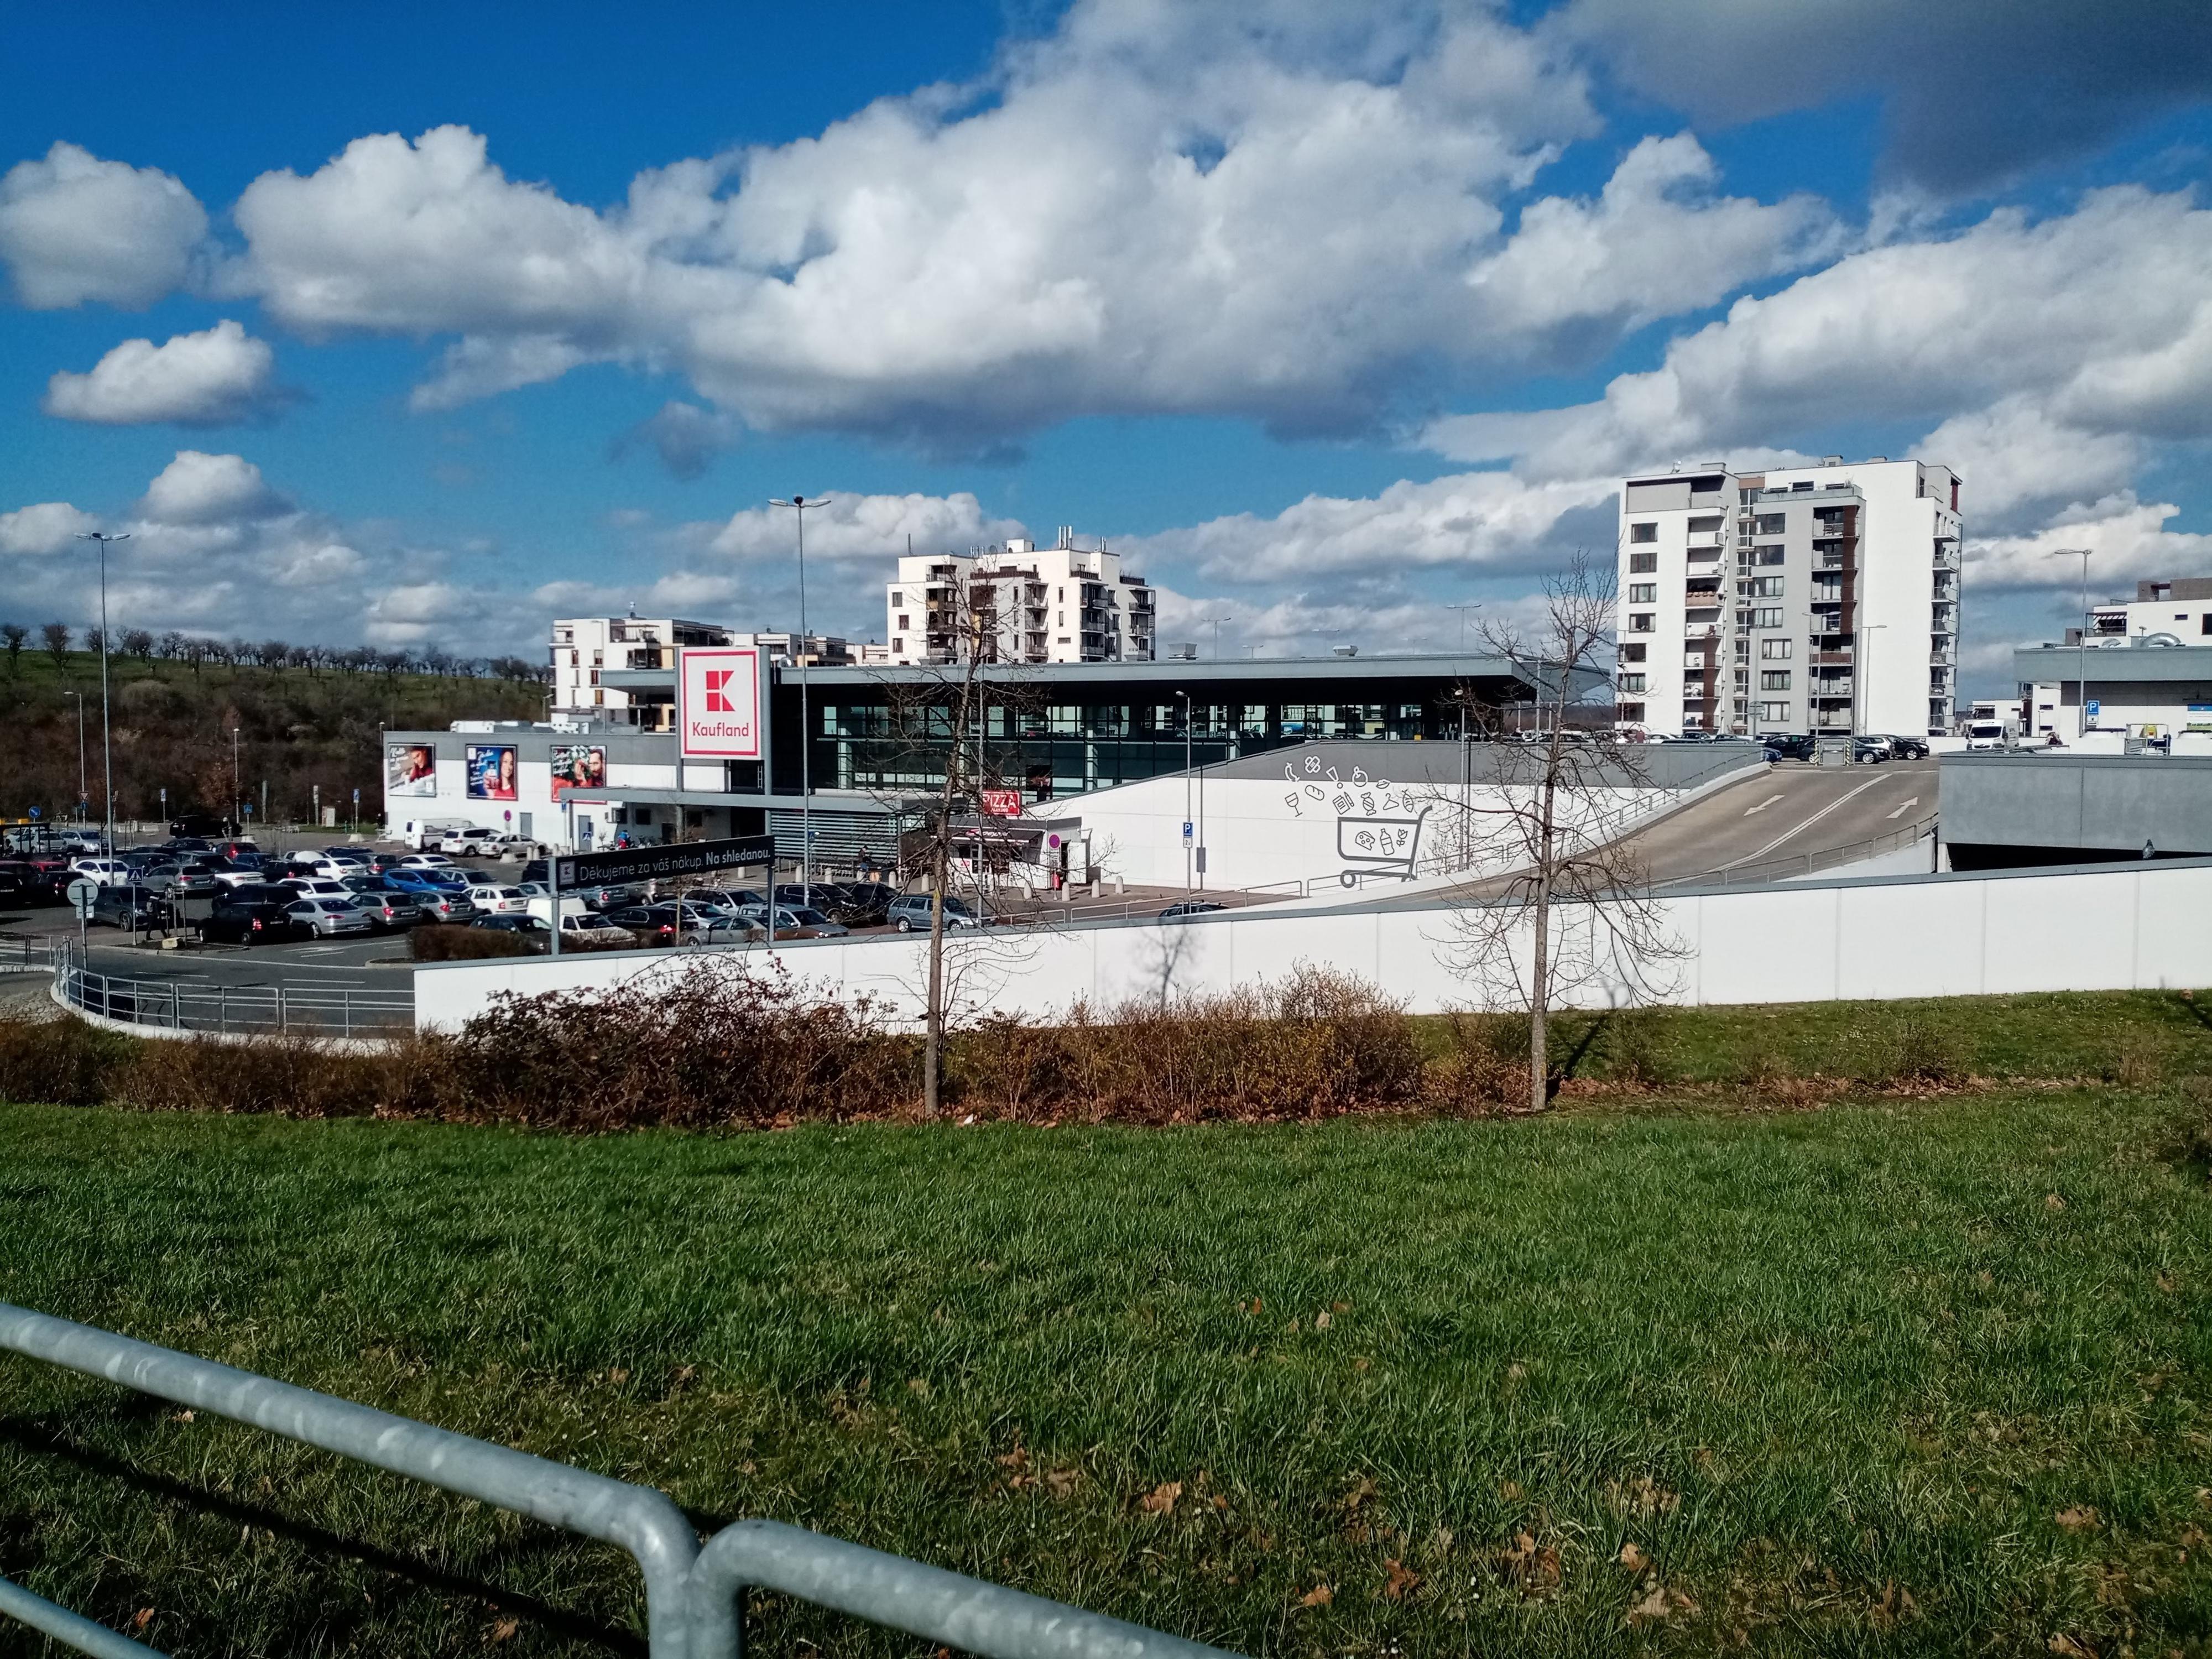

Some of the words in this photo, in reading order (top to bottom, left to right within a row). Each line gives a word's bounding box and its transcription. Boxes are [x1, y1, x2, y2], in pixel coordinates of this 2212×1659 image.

[706, 671, 735, 711] K
[2089, 703, 2096, 711] P
[693, 722, 749, 737] Kaufland
[1185, 824, 1191, 833] P
[580, 864, 635, 881] Děkujeme
[638, 863, 650, 874] za
[653, 858, 669, 872] váš
[672, 855, 703, 869] nákup.
[706, 852, 719, 865] Na
[722, 848, 770, 863] shledanou.
